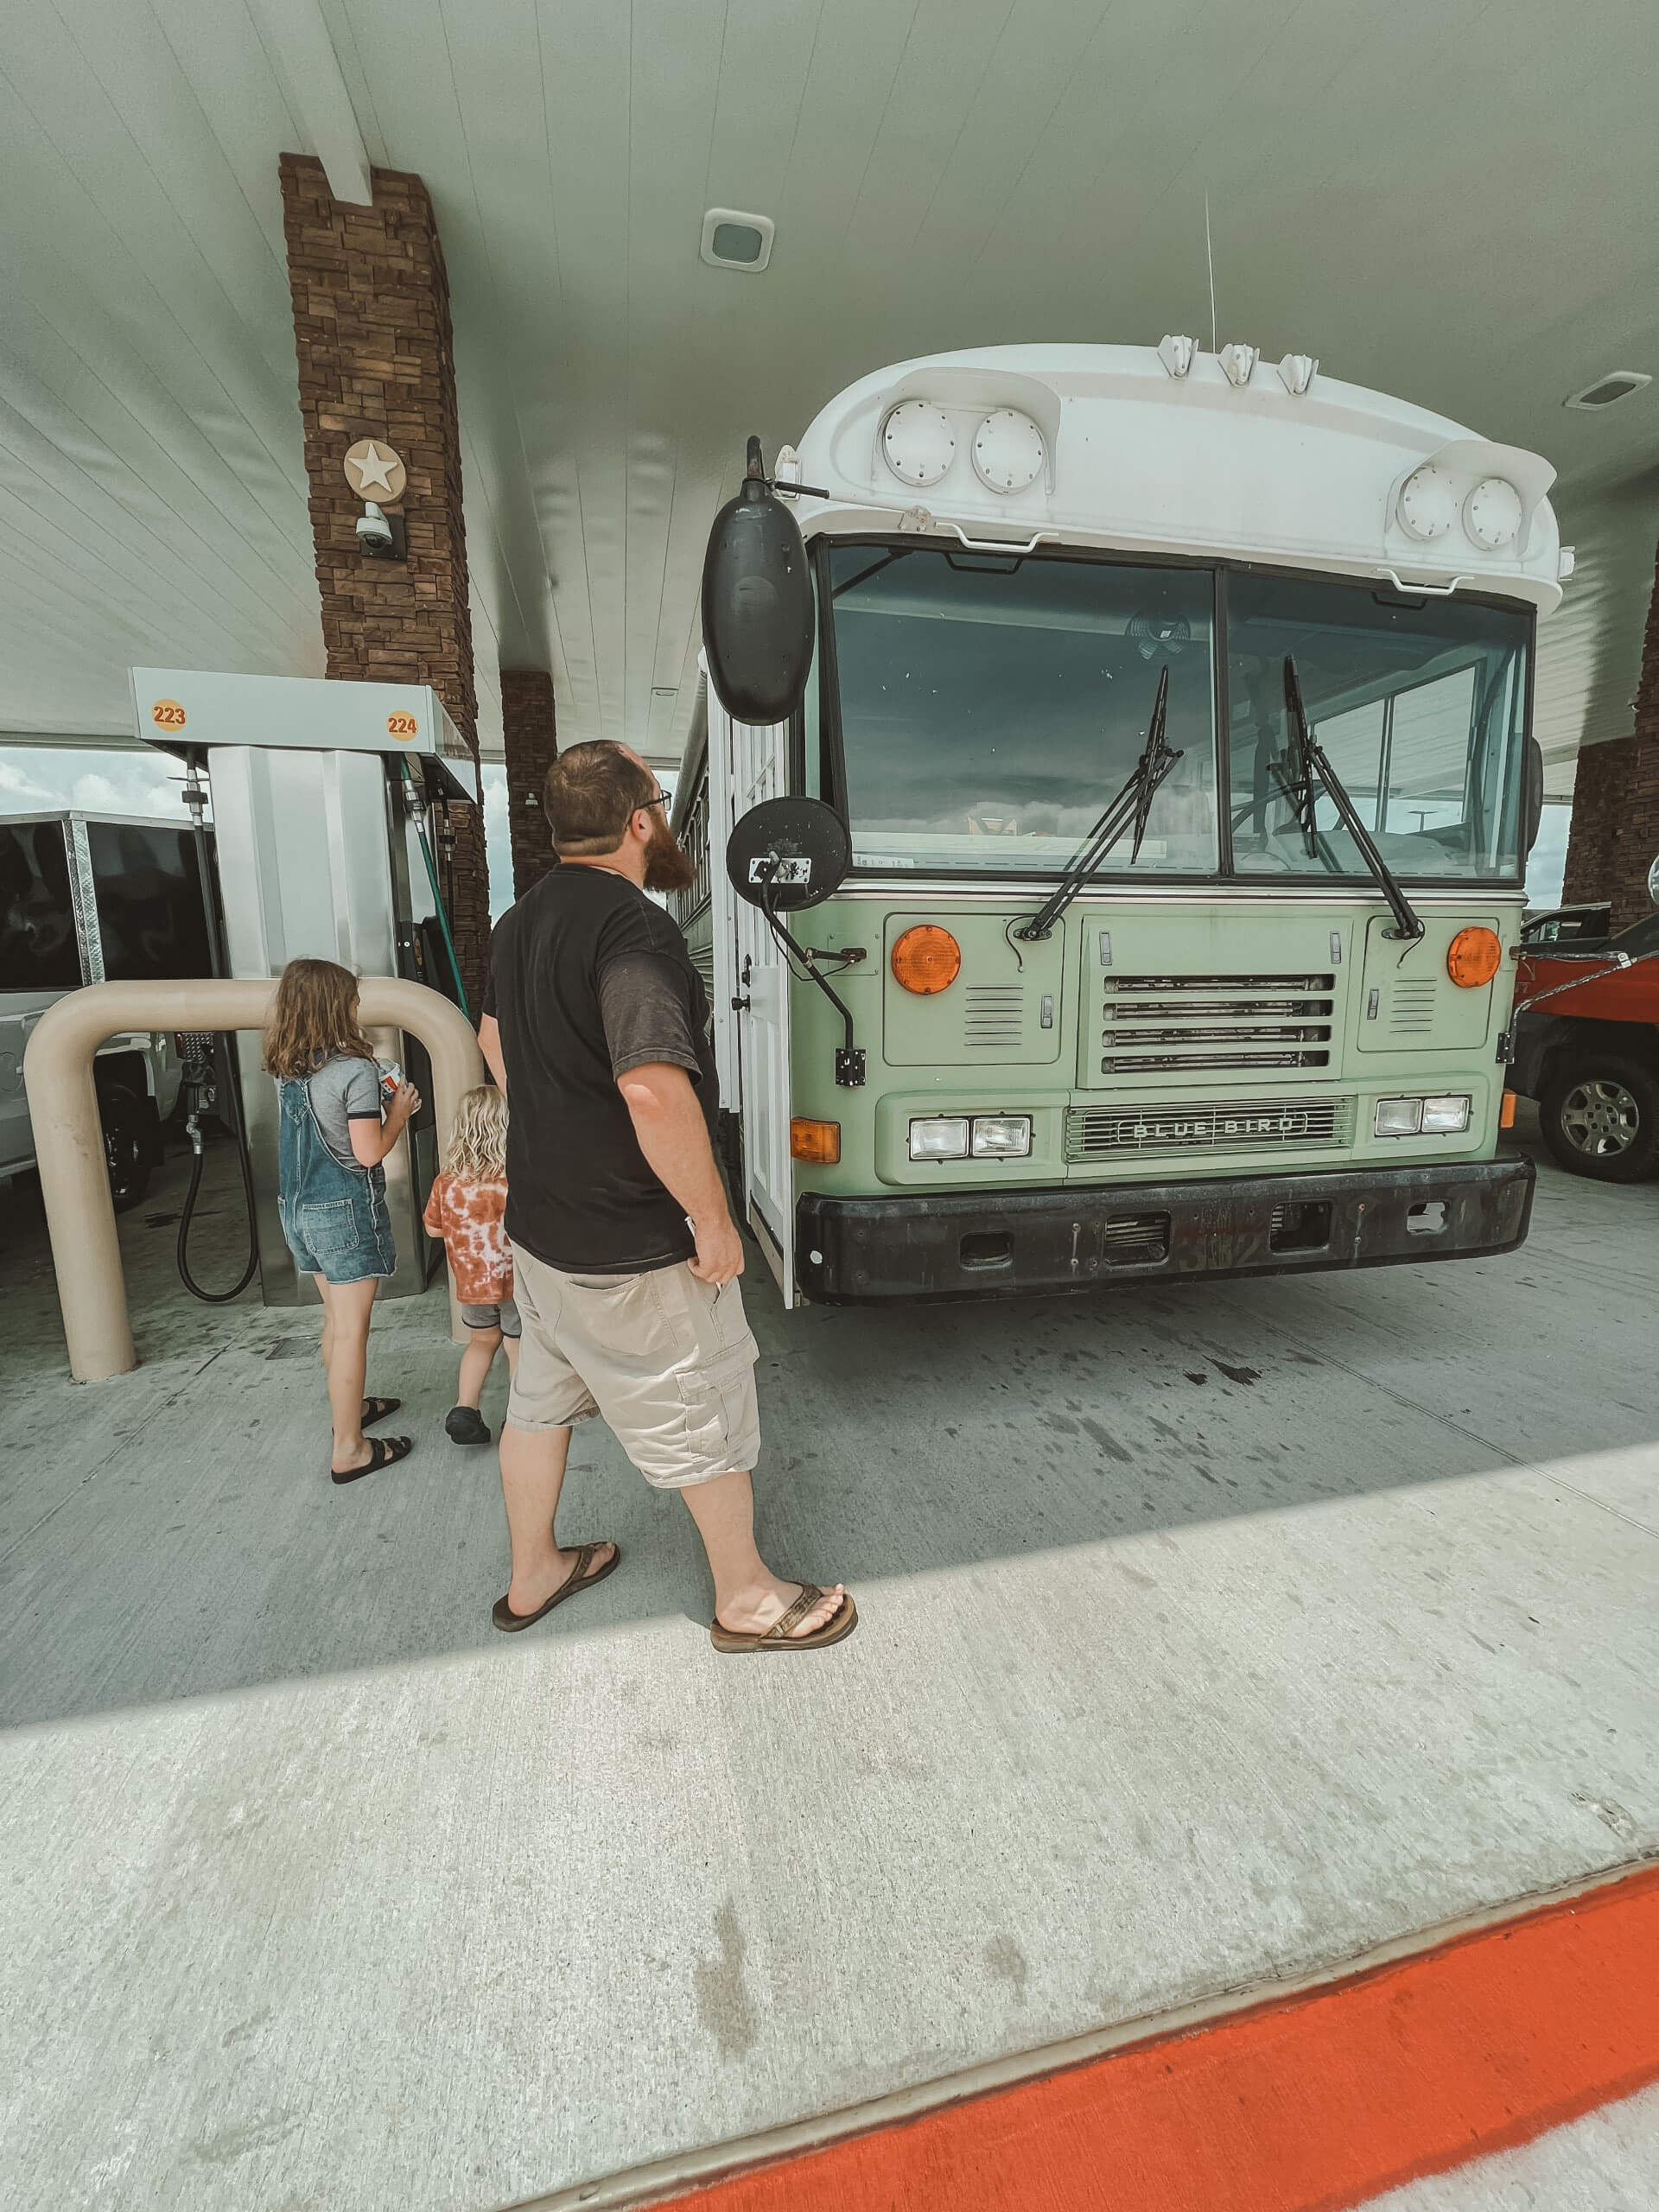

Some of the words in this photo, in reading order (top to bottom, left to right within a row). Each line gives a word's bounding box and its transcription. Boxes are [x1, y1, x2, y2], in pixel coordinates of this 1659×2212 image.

[152, 705, 187, 726] 223
[387, 717, 417, 734] 224
[1134, 1122, 1207, 1138] BLUE
[1224, 1117, 1293, 1134] BIRD
